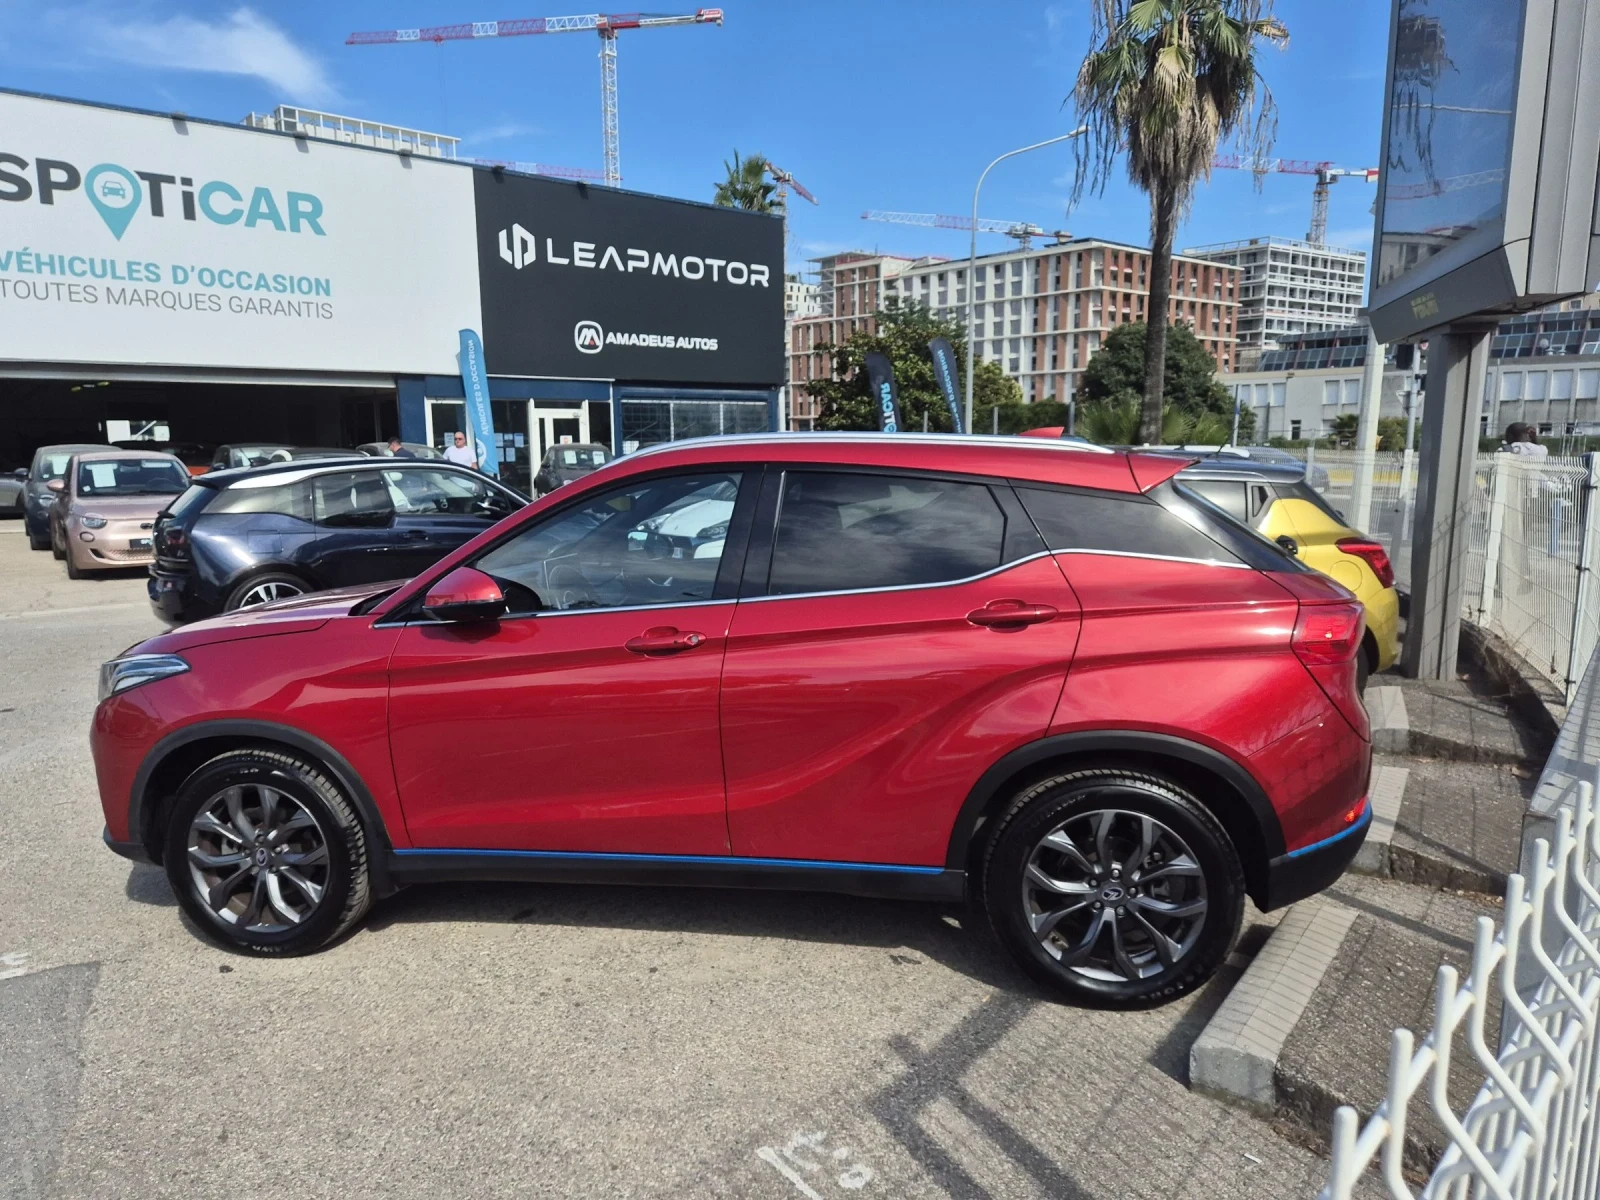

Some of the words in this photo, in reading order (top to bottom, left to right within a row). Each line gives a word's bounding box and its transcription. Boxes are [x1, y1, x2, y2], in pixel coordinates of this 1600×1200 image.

[0, 246, 161, 283] VÉHICULES
[171, 264, 332, 297] D'OCCASION
[546, 237, 770, 288] LEAPMOTOR
[0, 278, 99, 304] TOUTES
[106, 286, 222, 314] MARQUES
[228, 295, 334, 320] GARANTIS
[605, 331, 675, 349] AMADEUS
[676, 336, 719, 351] AUTOS
